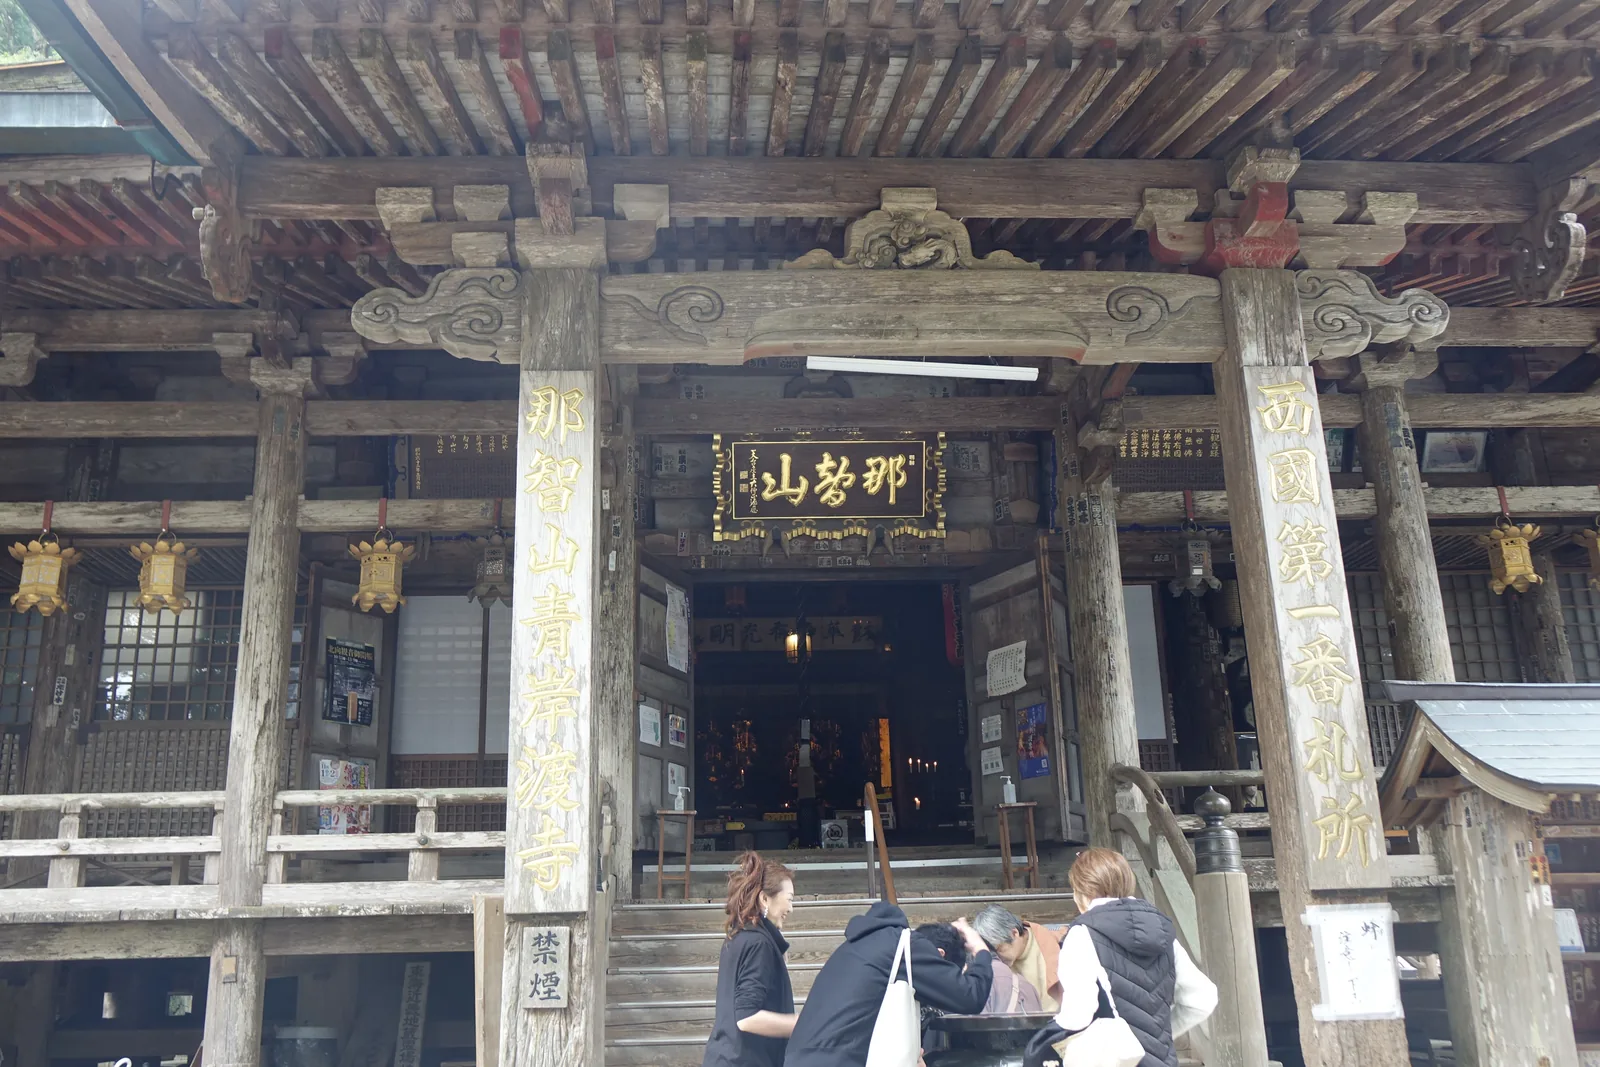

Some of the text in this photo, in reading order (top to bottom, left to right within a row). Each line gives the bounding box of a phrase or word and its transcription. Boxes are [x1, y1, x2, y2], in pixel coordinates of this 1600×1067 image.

[515, 385, 584, 892] 那智山青岸渡寺
[1256, 380, 1373, 868] 西國第一番札所
[528, 931, 562, 1002] 禁煙
